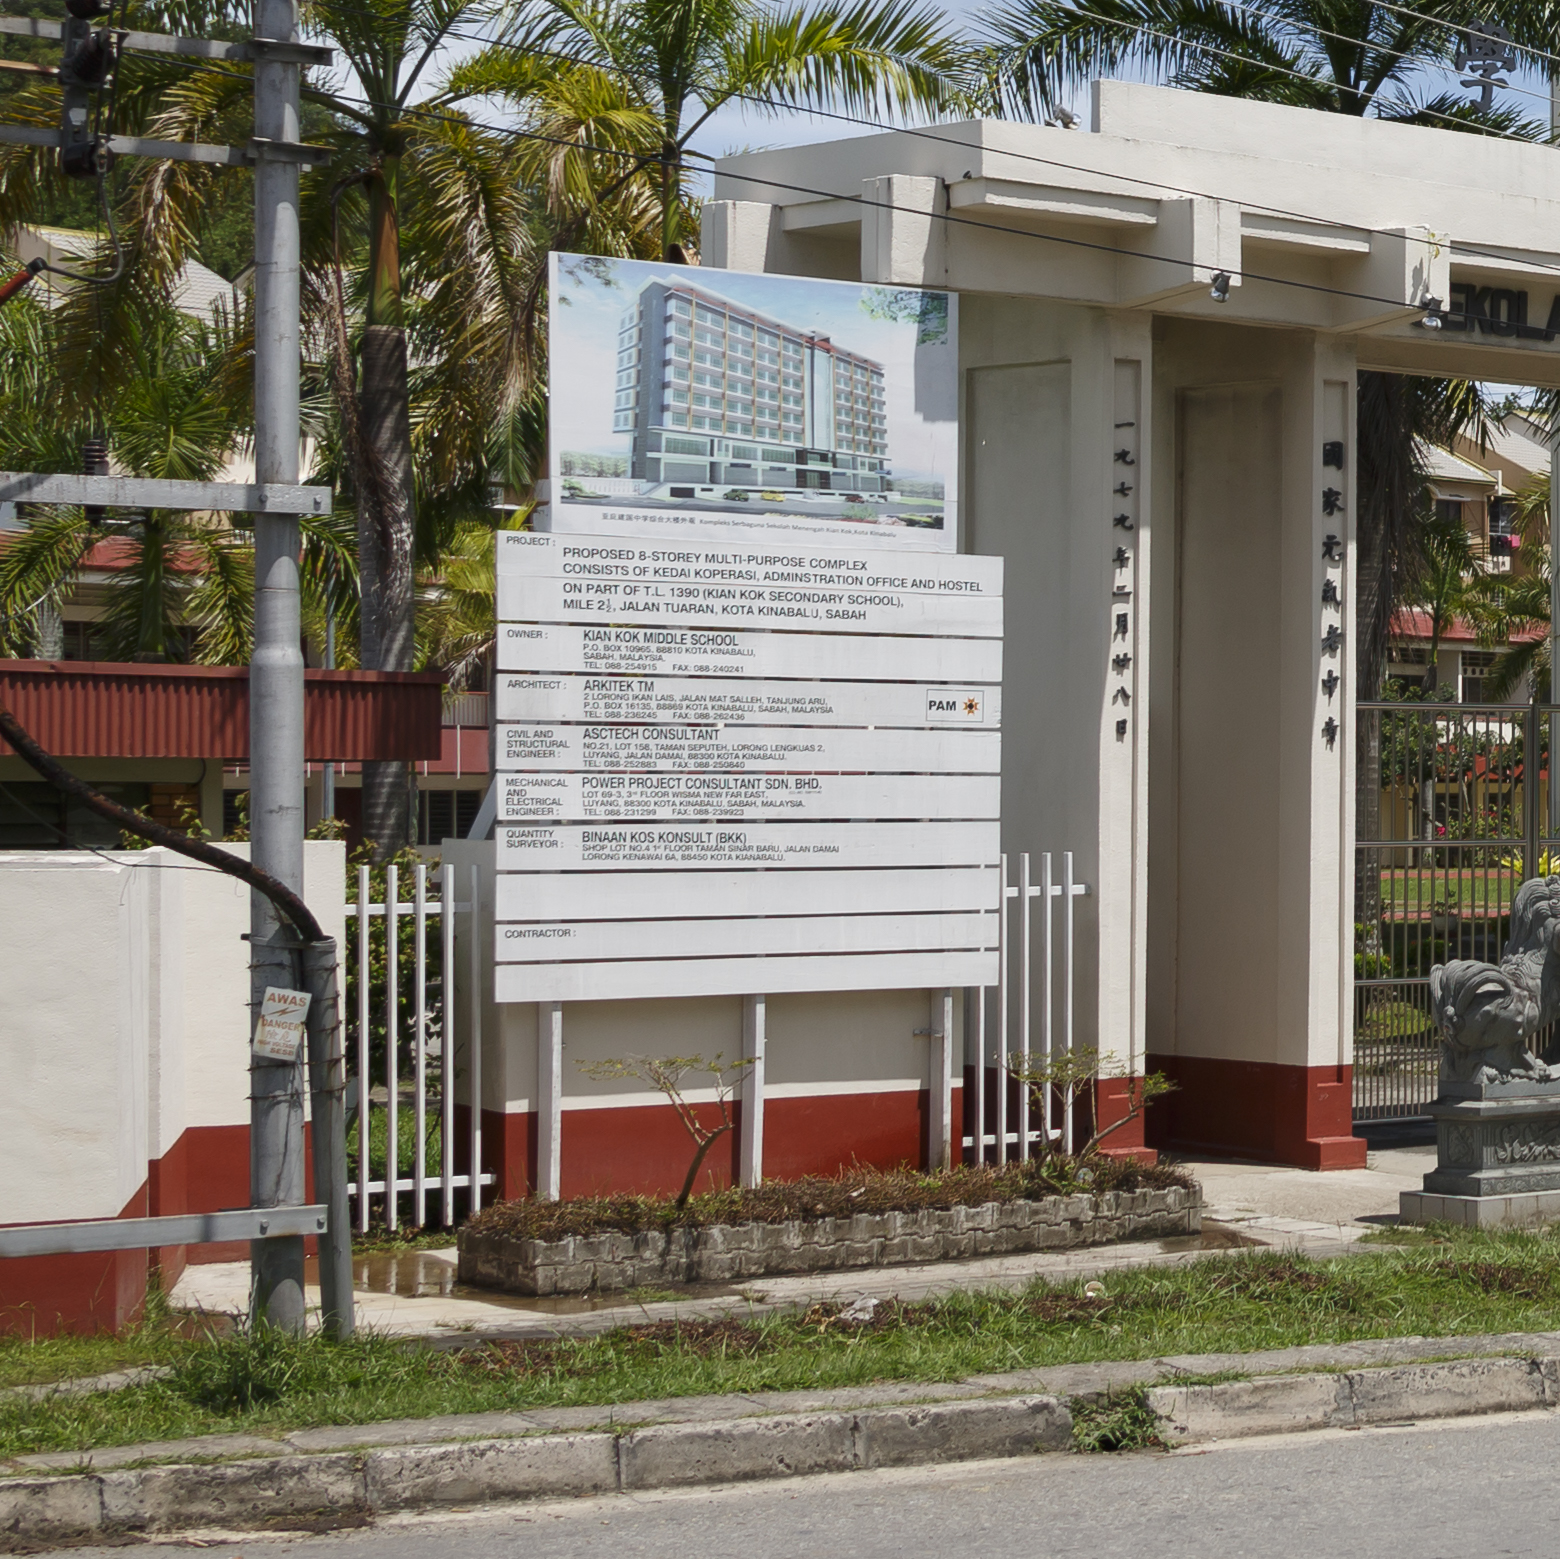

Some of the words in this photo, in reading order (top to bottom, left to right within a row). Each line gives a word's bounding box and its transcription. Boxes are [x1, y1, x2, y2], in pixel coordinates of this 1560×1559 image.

[562, 546, 635, 560] PROPOSED
[638, 550, 701, 563] 8-STOREY
[704, 552, 806, 567] MULTI-PURPOSE
[809, 558, 867, 570] COMPLEX
[562, 562, 629, 576] CONSISTS
[632, 565, 649, 576] OF
[653, 566, 691, 578] KEDAI
[763, 571, 863, 585] ADMINSTRATION
[866, 576, 908, 588] OFFICE
[910, 578, 935, 589] AND
[938, 579, 982, 592] HOSTEL
[562, 582, 582, 593] ON
[585, 583, 618, 594] PART
[622, 584, 640, 596] OF
[670, 586, 700, 598] 1390
[702, 587, 736, 599] (KIAN
[739, 589, 765, 601] KOK
[768, 590, 844, 604] SECONDARY
[563, 598, 594, 610] MILE
[619, 600, 660, 612] JALAN
[721, 604, 754, 615] KOTA
[825, 608, 867, 620] SABAH
[583, 629, 611, 642] KIAN
[614, 630, 640, 643] KOK
[643, 631, 688, 645] MIDDLE
[690, 633, 738, 646] SCHOOL
[583, 679, 634, 691] ARKITEK
[637, 680, 654, 691] TM
[928, 700, 957, 711] PAM
[506, 729, 531, 738] CIVIL
[532, 729, 554, 738] AND
[582, 727, 639, 739] ASCTECH
[642, 728, 720, 740] CONSULTANT
[506, 739, 569, 748] STRUCTURAL
[505, 778, 568, 787] MECHANICAL
[581, 776, 625, 788] POWER
[628, 776, 682, 789] PROJECT
[685, 777, 762, 789] CONSULTANT
[506, 788, 527, 796] AND
[505, 797, 563, 806] ELECTRICAL
[506, 829, 554, 838] QUANTITY
[581, 831, 627, 842] BINAAN
[629, 831, 655, 843] KOS
[657, 831, 712, 843] KONSULT
[715, 832, 747, 843] (BKK)
[266, 992, 307, 1007] AWAS
[261, 1019, 300, 1031] DANGER
[270, 1047, 294, 1056] SESB
